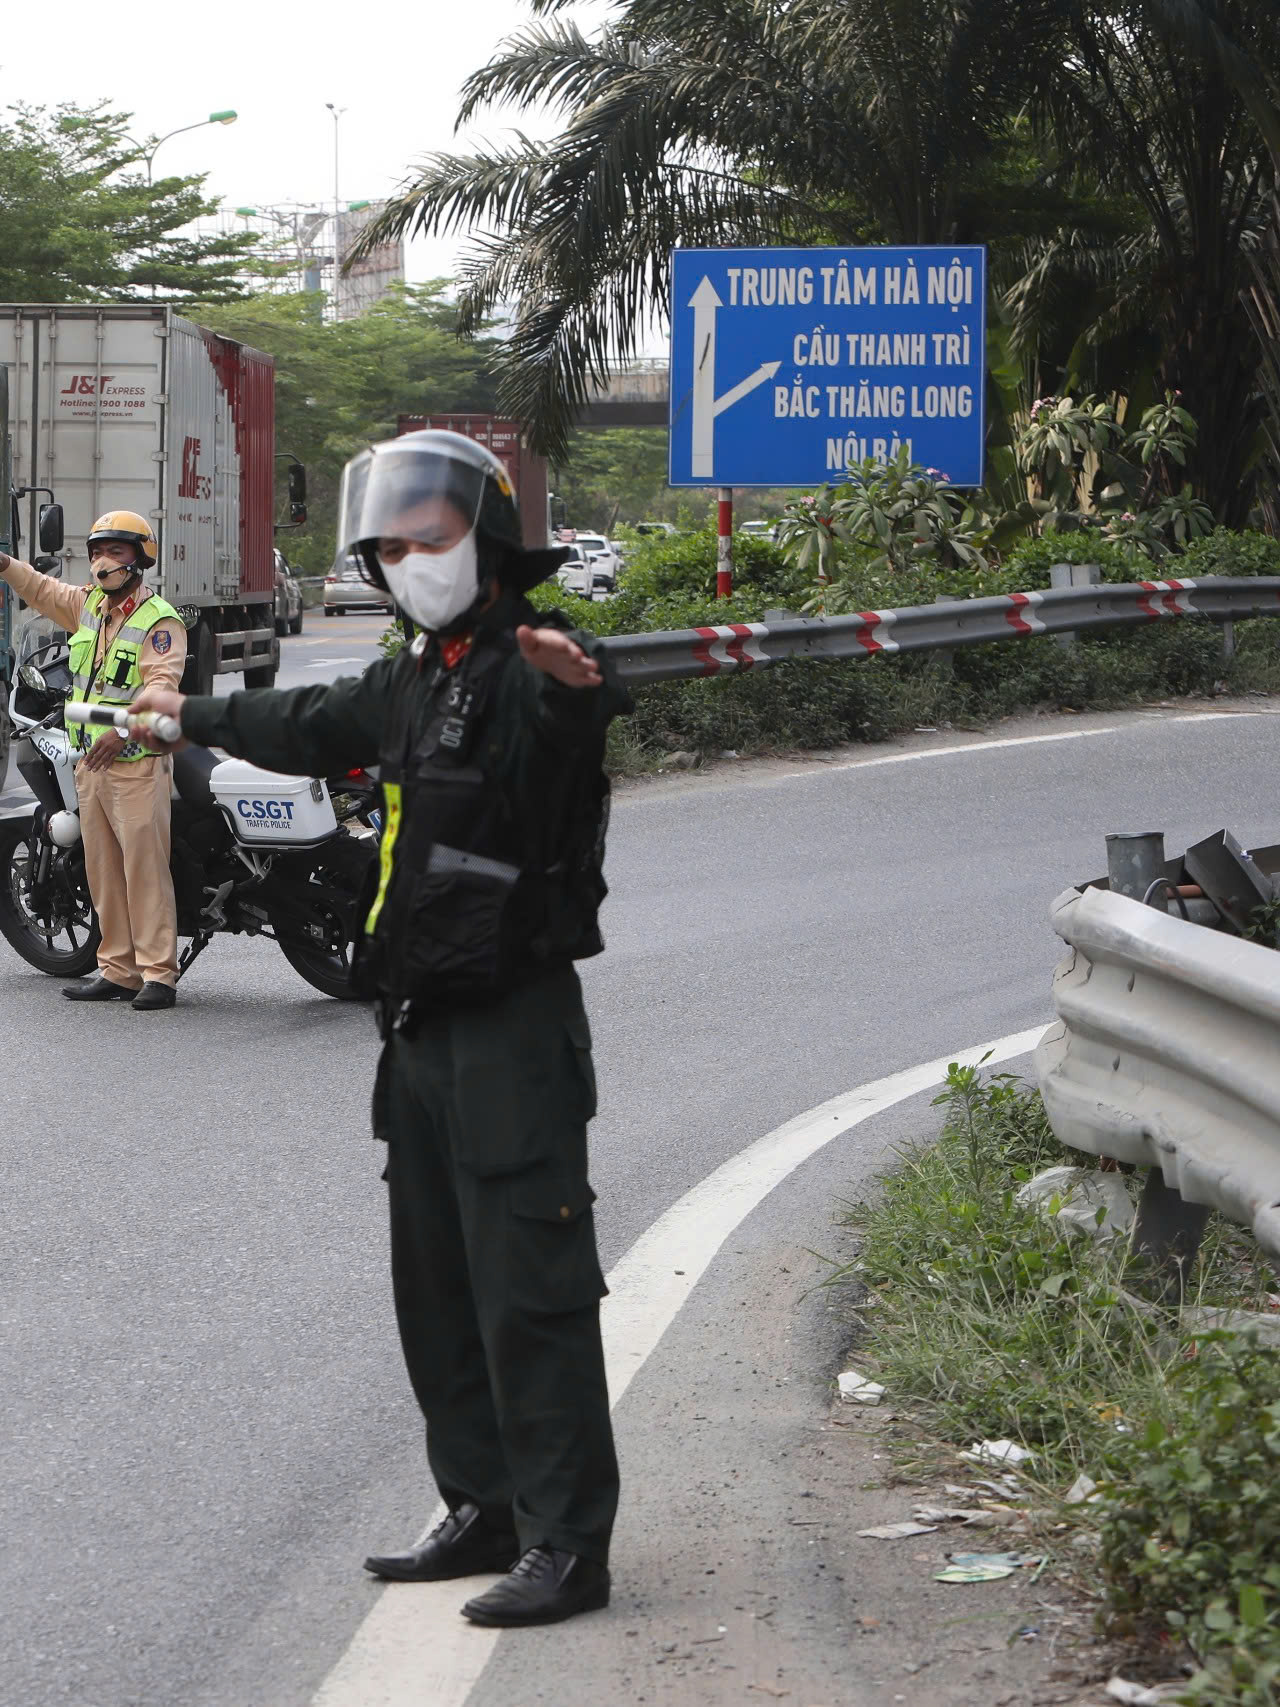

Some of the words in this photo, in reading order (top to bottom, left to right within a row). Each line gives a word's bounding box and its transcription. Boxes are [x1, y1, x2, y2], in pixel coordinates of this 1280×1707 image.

[727, 266, 814, 306] TRUNG
[820, 258, 876, 305] TÂM
[884, 258, 920, 305] HÀ
[927, 257, 972, 312] NỘI
[793, 324, 840, 366] CẦU
[846, 333, 926, 366] THANH
[932, 325, 970, 365] TRÌ
[60, 375, 117, 394] J&T
[106, 386, 146, 395] EXPRESS
[774, 373, 821, 418] BẮC
[826, 379, 905, 418] THĂNG
[911, 385, 973, 418] LONG
[60, 399, 97, 407] Hotline:
[99, 400, 121, 408] 1900
[124, 400, 146, 408] 1088
[872, 430, 913, 469] BÀI
[38, 737, 62, 760] CSGT
[237, 799, 295, 820] C.S.G.T
[246, 819, 270, 829] TRAFFIC
[270, 820, 292, 829] POLICE
